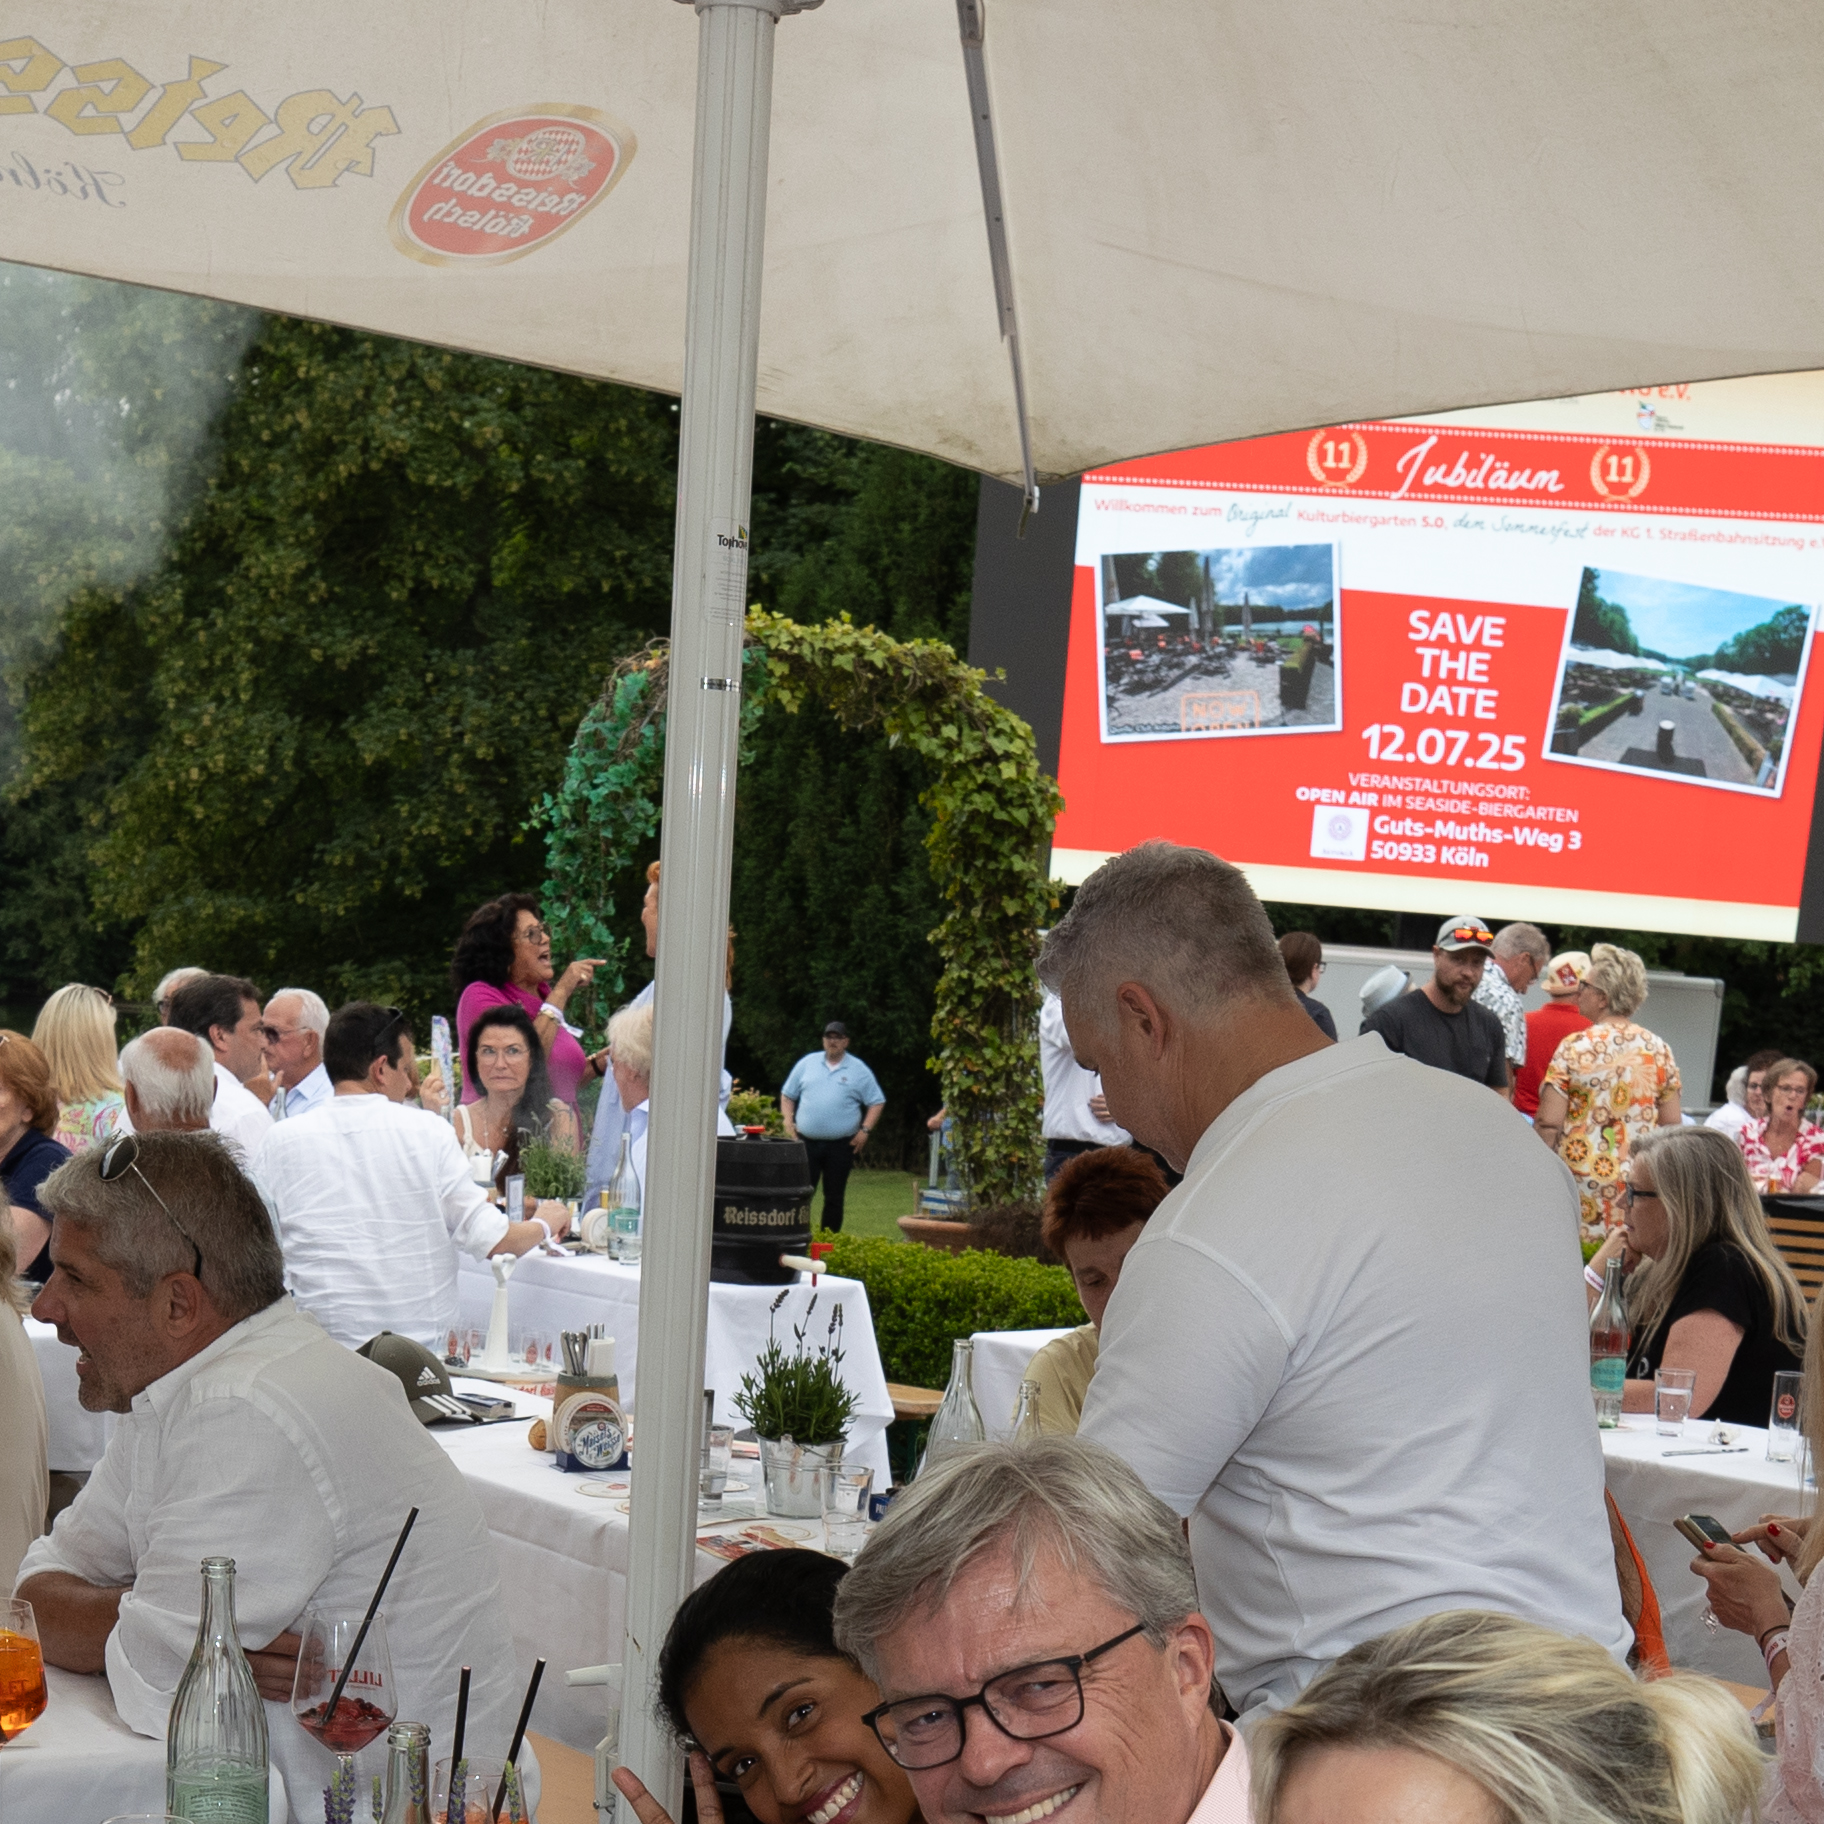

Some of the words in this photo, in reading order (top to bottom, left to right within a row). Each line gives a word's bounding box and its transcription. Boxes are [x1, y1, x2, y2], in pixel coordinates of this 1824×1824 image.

[1324, 442, 1352, 470] 11
[1391, 434, 1564, 500] Jubiläum
[1606, 455, 1636, 482] 11
[1094, 498, 1188, 517] Willkommen
[1192, 504, 1222, 517] zum
[1226, 501, 1292, 537] Original
[1297, 509, 1416, 529] Kulturbiergarten
[1491, 514, 1589, 544] Sommerfest
[1593, 524, 1618, 538] der
[1620, 525, 1641, 539] KG
[1659, 528, 1806, 550] Straßenbahnsitzung
[1408, 609, 1507, 648] SAVE
[1415, 647, 1492, 683] THE
[1400, 682, 1499, 720] DATE
[1361, 723, 1527, 772] 12.07.25
[1295, 786, 1347, 805] OPEN
[1348, 790, 1380, 807] AIR
[1382, 793, 1402, 809] IM
[1405, 795, 1580, 823] SEASIDE-BIERGARTEN
[1348, 772, 1531, 801] VERANSTALTUNGSORT:
[1373, 815, 1564, 853] Guts-Muths-Weg
[1568, 830, 1582, 850] 3
[1370, 841, 1437, 863] 50933
[1440, 844, 1490, 868] Köln
[723, 1204, 797, 1227] Reissdorf
[417, 1378, 441, 1386] adidas
